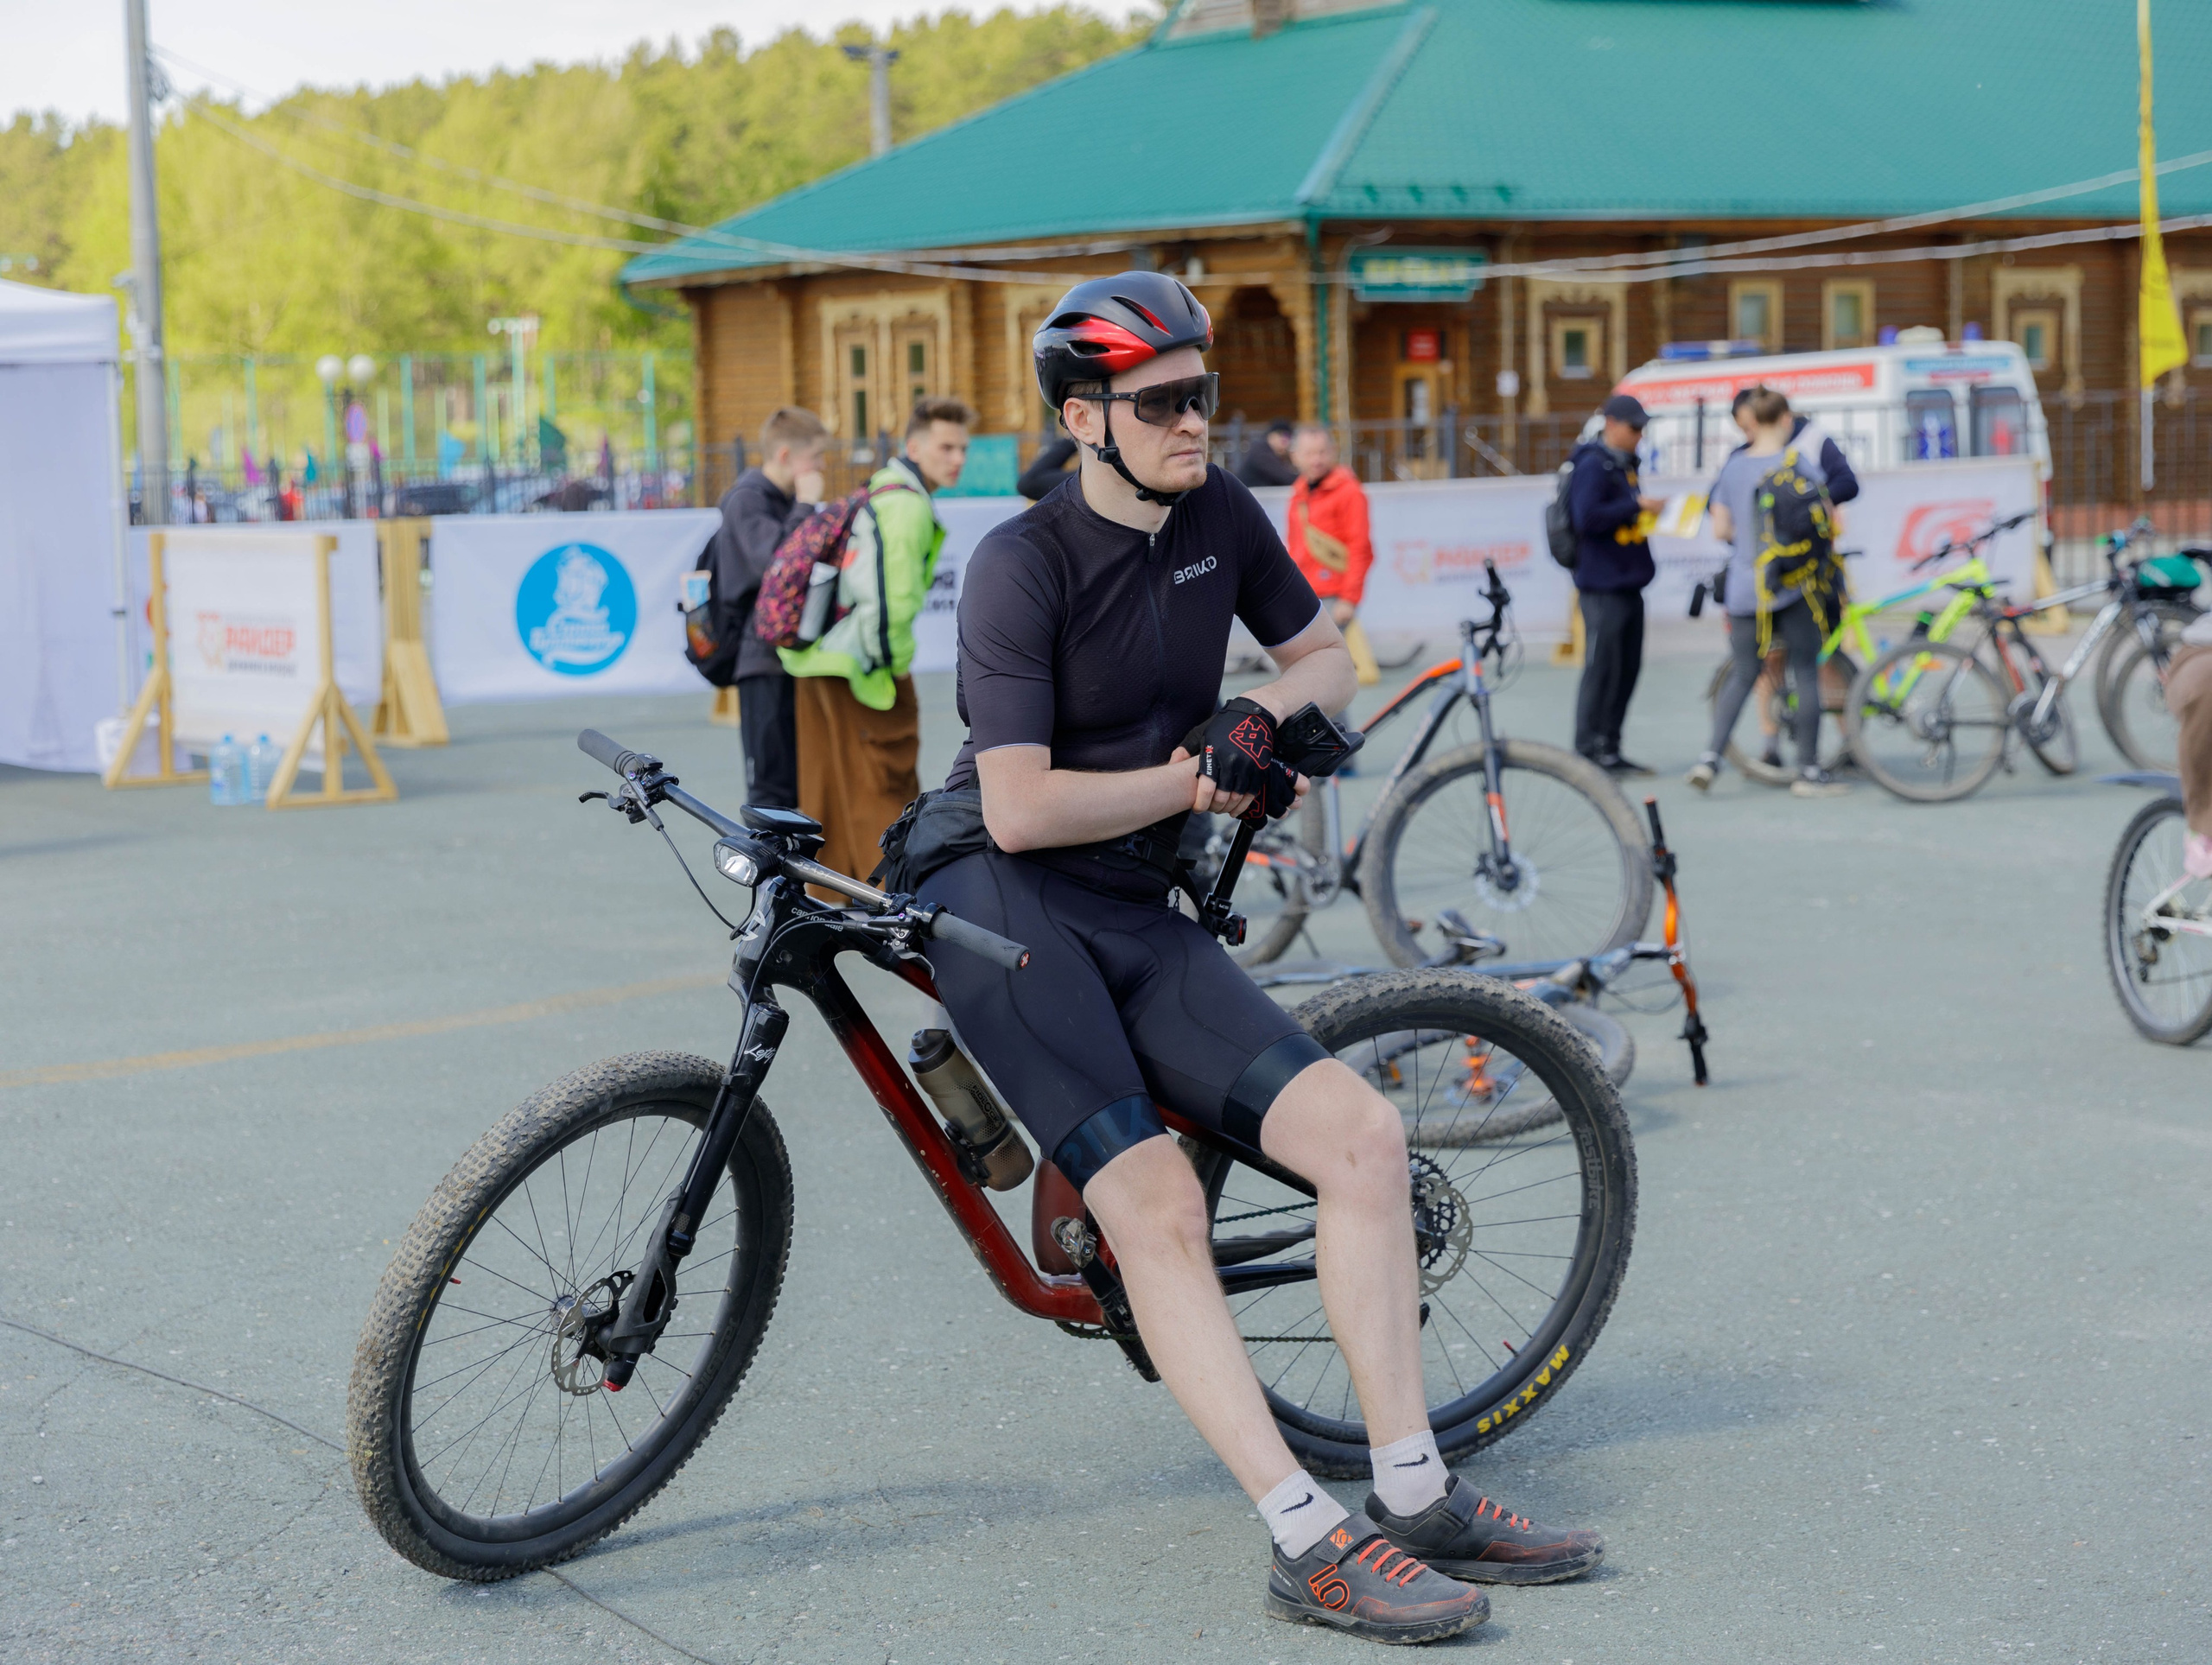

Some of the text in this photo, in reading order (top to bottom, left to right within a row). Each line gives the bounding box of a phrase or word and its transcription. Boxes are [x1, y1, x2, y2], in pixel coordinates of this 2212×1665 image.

[1173, 556, 1217, 585] BRIKO
[973, 1084, 1001, 1124] FIDLOCK
[1477, 1344, 1570, 1433] MAXXIS
